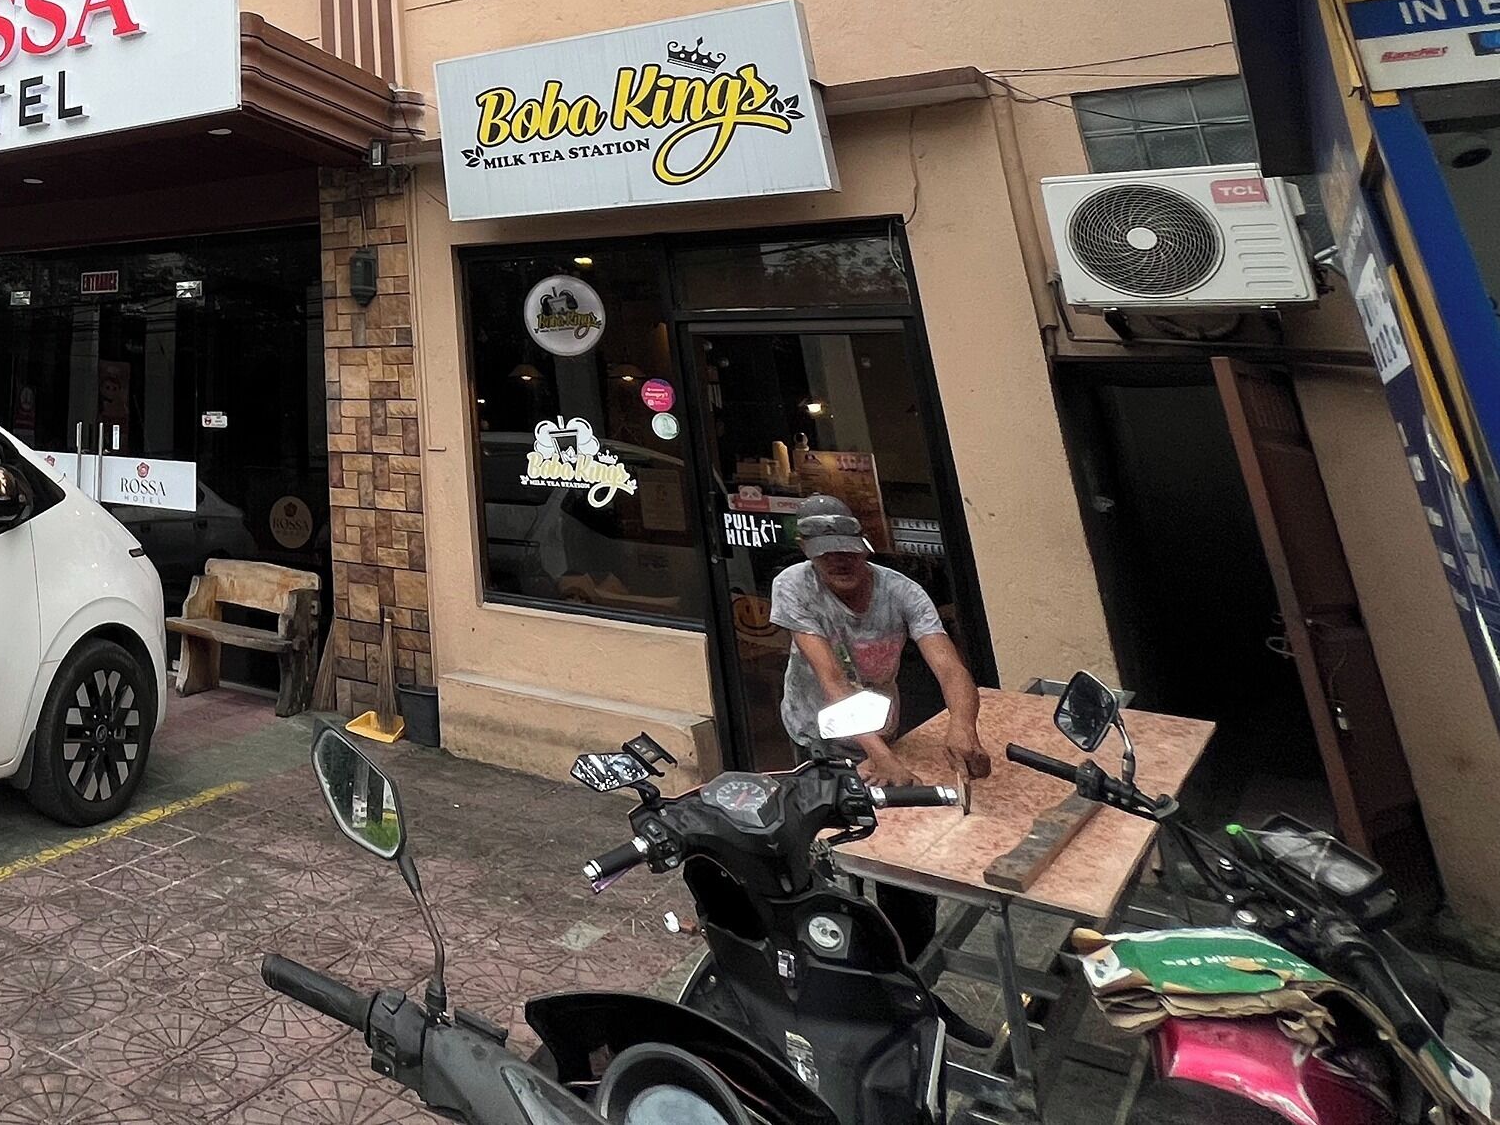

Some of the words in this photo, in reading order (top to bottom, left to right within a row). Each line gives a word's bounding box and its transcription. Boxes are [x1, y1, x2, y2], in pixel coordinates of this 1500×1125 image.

[475, 80, 607, 148] Boba
[610, 63, 792, 186] Kings
[483, 152, 527, 170] MILK
[529, 149, 566, 167] TEA
[568, 137, 651, 160] STATION
[1218, 185, 1261, 196] TCL
[120, 477, 166, 497] ROSSA
[526, 451, 576, 481] Boba
[575, 454, 635, 508] Kings
[124, 494, 162, 505] HOTEL
[724, 512, 759, 531] PULL
[725, 529, 762, 547] HILA
